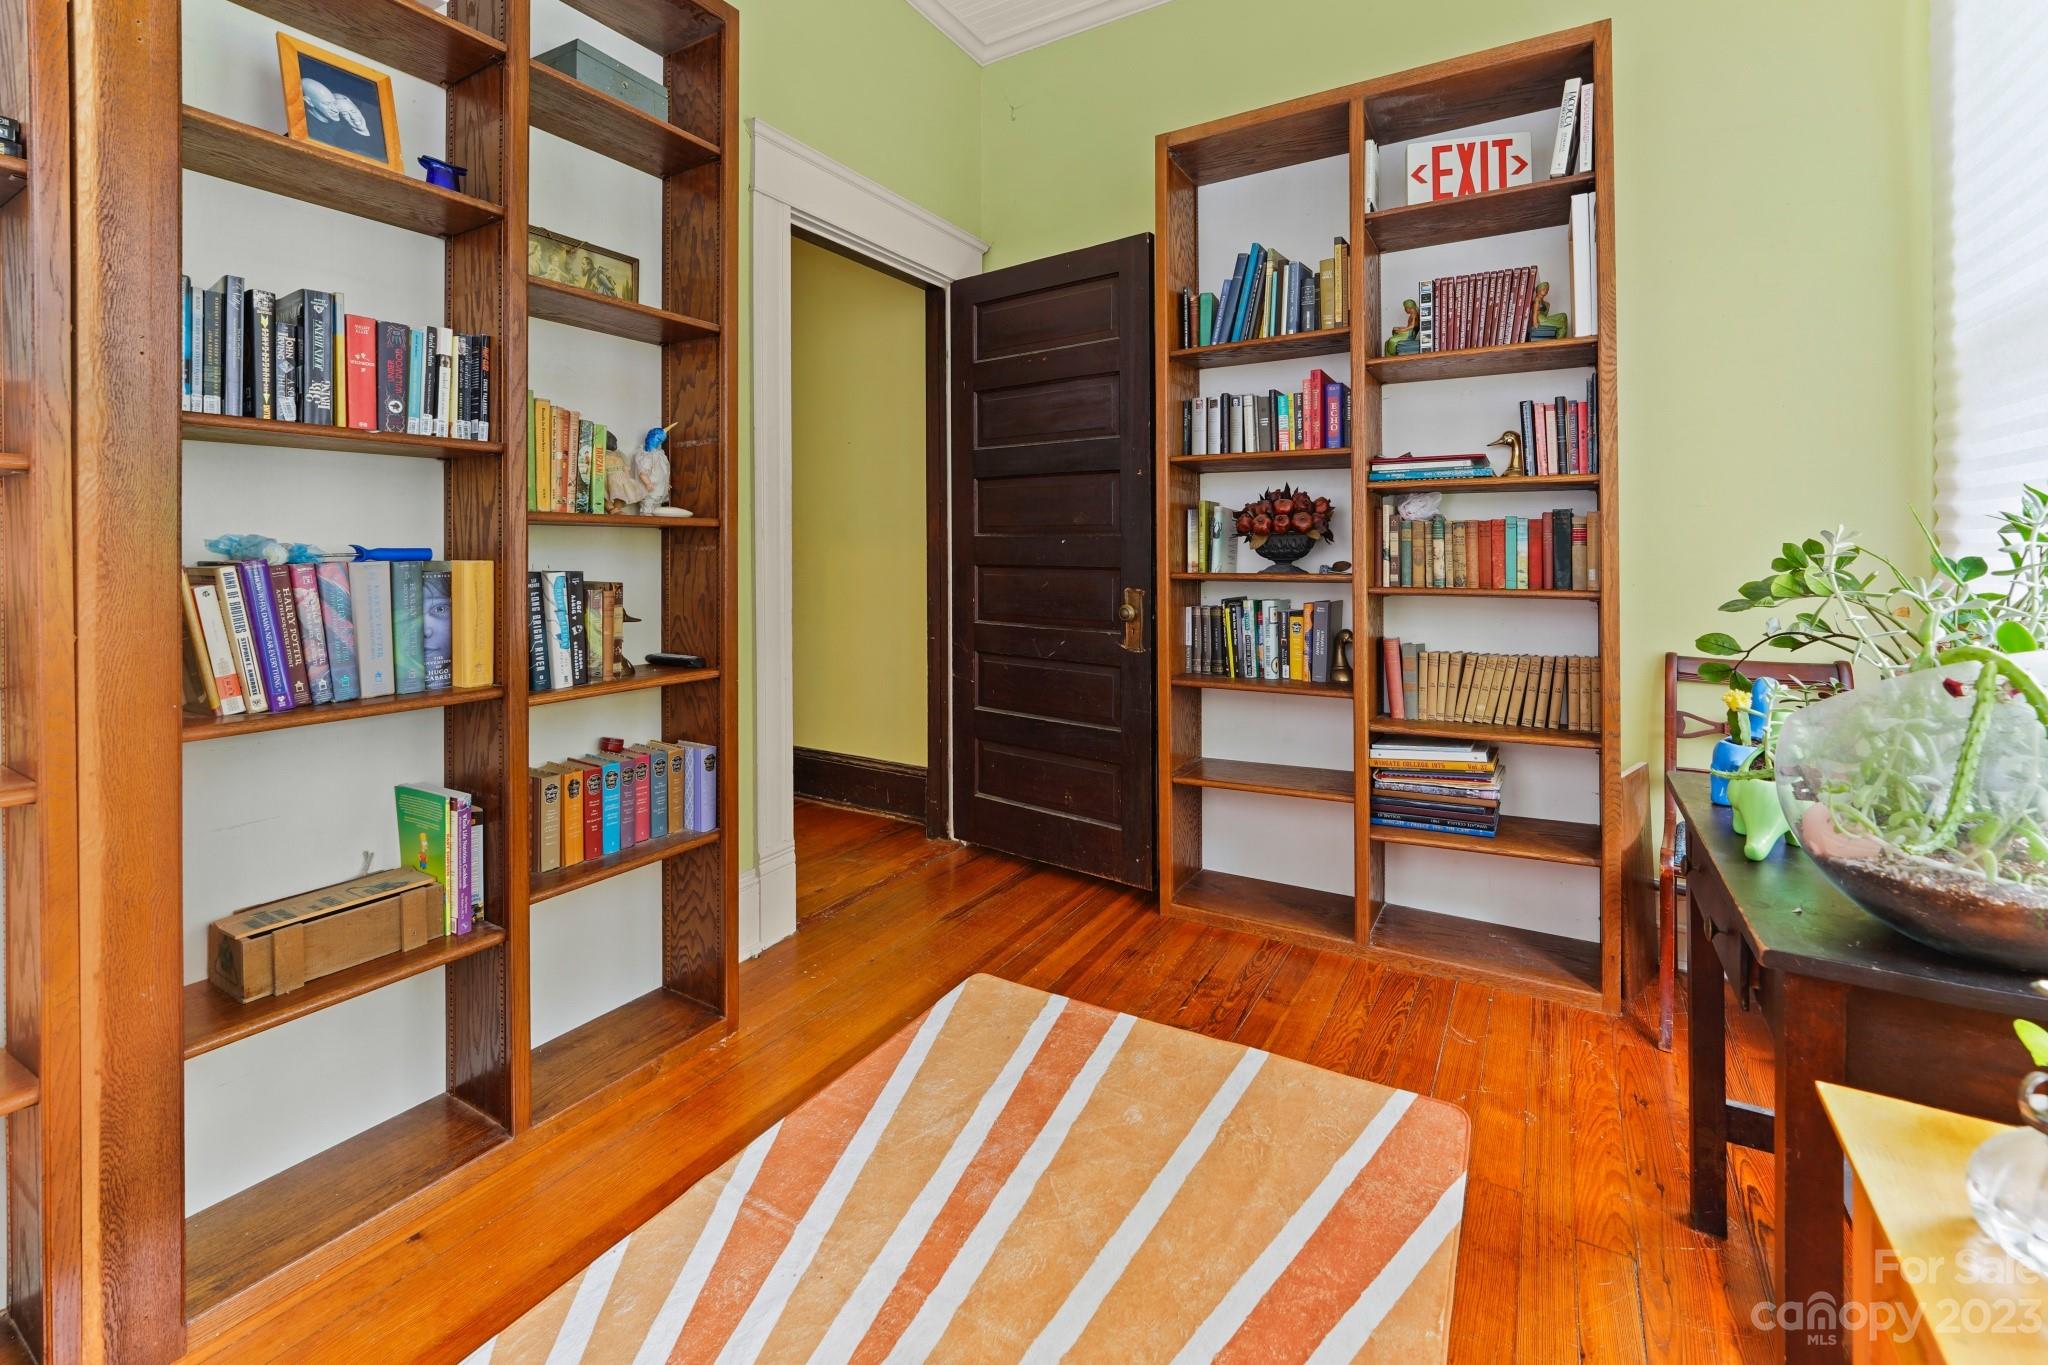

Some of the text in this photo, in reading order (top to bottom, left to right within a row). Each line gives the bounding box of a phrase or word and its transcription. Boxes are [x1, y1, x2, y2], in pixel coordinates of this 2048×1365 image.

[1563, 90, 1577, 128] IACOCCA
[1431, 138, 1513, 201] EXIT
[276, 332, 289, 360] IRVING
[285, 336, 296, 359] JOHN
[1330, 402, 1338, 431] ECHO
[222, 571, 235, 590] BAND
[229, 601, 247, 634] BROTHERS
[260, 612, 271, 631] DAMN
[282, 587, 302, 666] HARRY POTTER
[530, 591, 545, 672] LONG BRIGHT RIVER
[240, 637, 250, 662] STEPHEN
[263, 631, 273, 648] NEAR
[268, 649, 282, 688] EVERYTHING
[428, 668, 449, 676] HUGO
